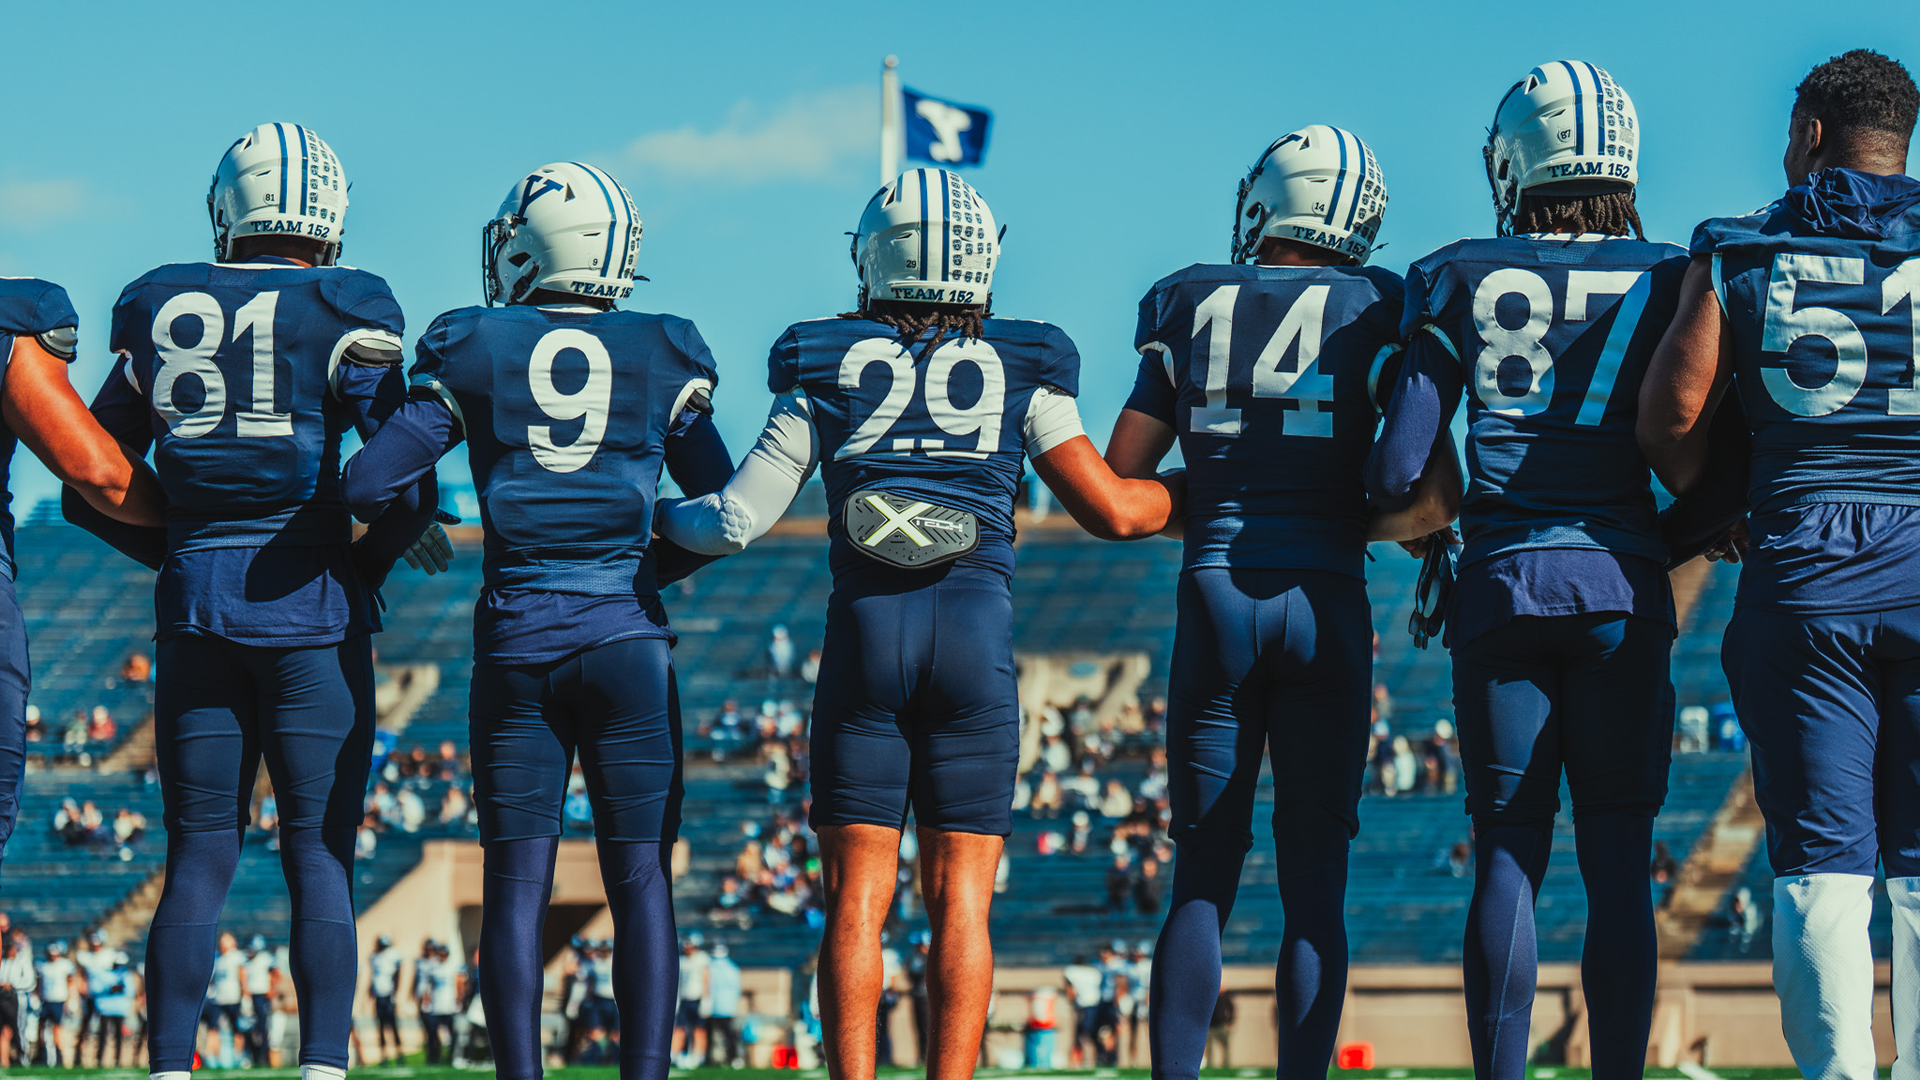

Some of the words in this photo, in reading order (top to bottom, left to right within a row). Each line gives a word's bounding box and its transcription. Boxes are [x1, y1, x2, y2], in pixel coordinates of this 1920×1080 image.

[1560, 128, 1572, 140] 87
[1547, 161, 1604, 178] TEAM
[1607, 163, 1631, 179] 152
[265, 193, 275, 202] 81
[512, 174, 564, 226] Y
[1314, 202, 1326, 212] 14
[251, 220, 303, 233] TEAM
[307, 223, 330, 239] 152
[1293, 225, 1346, 250] TEAM
[1345, 240, 1367, 258] 152
[592, 258, 599, 266] 9
[906, 260, 917, 269] 29
[570, 280, 618, 298] TEAM
[891, 287, 944, 301] TEAM
[949, 290, 975, 304] 152
[1472, 267, 1652, 427] 87
[152, 290, 295, 439] 81
[1190, 284, 1334, 438] 14
[528, 329, 612, 473] 9
[833, 336, 1006, 462] 29
